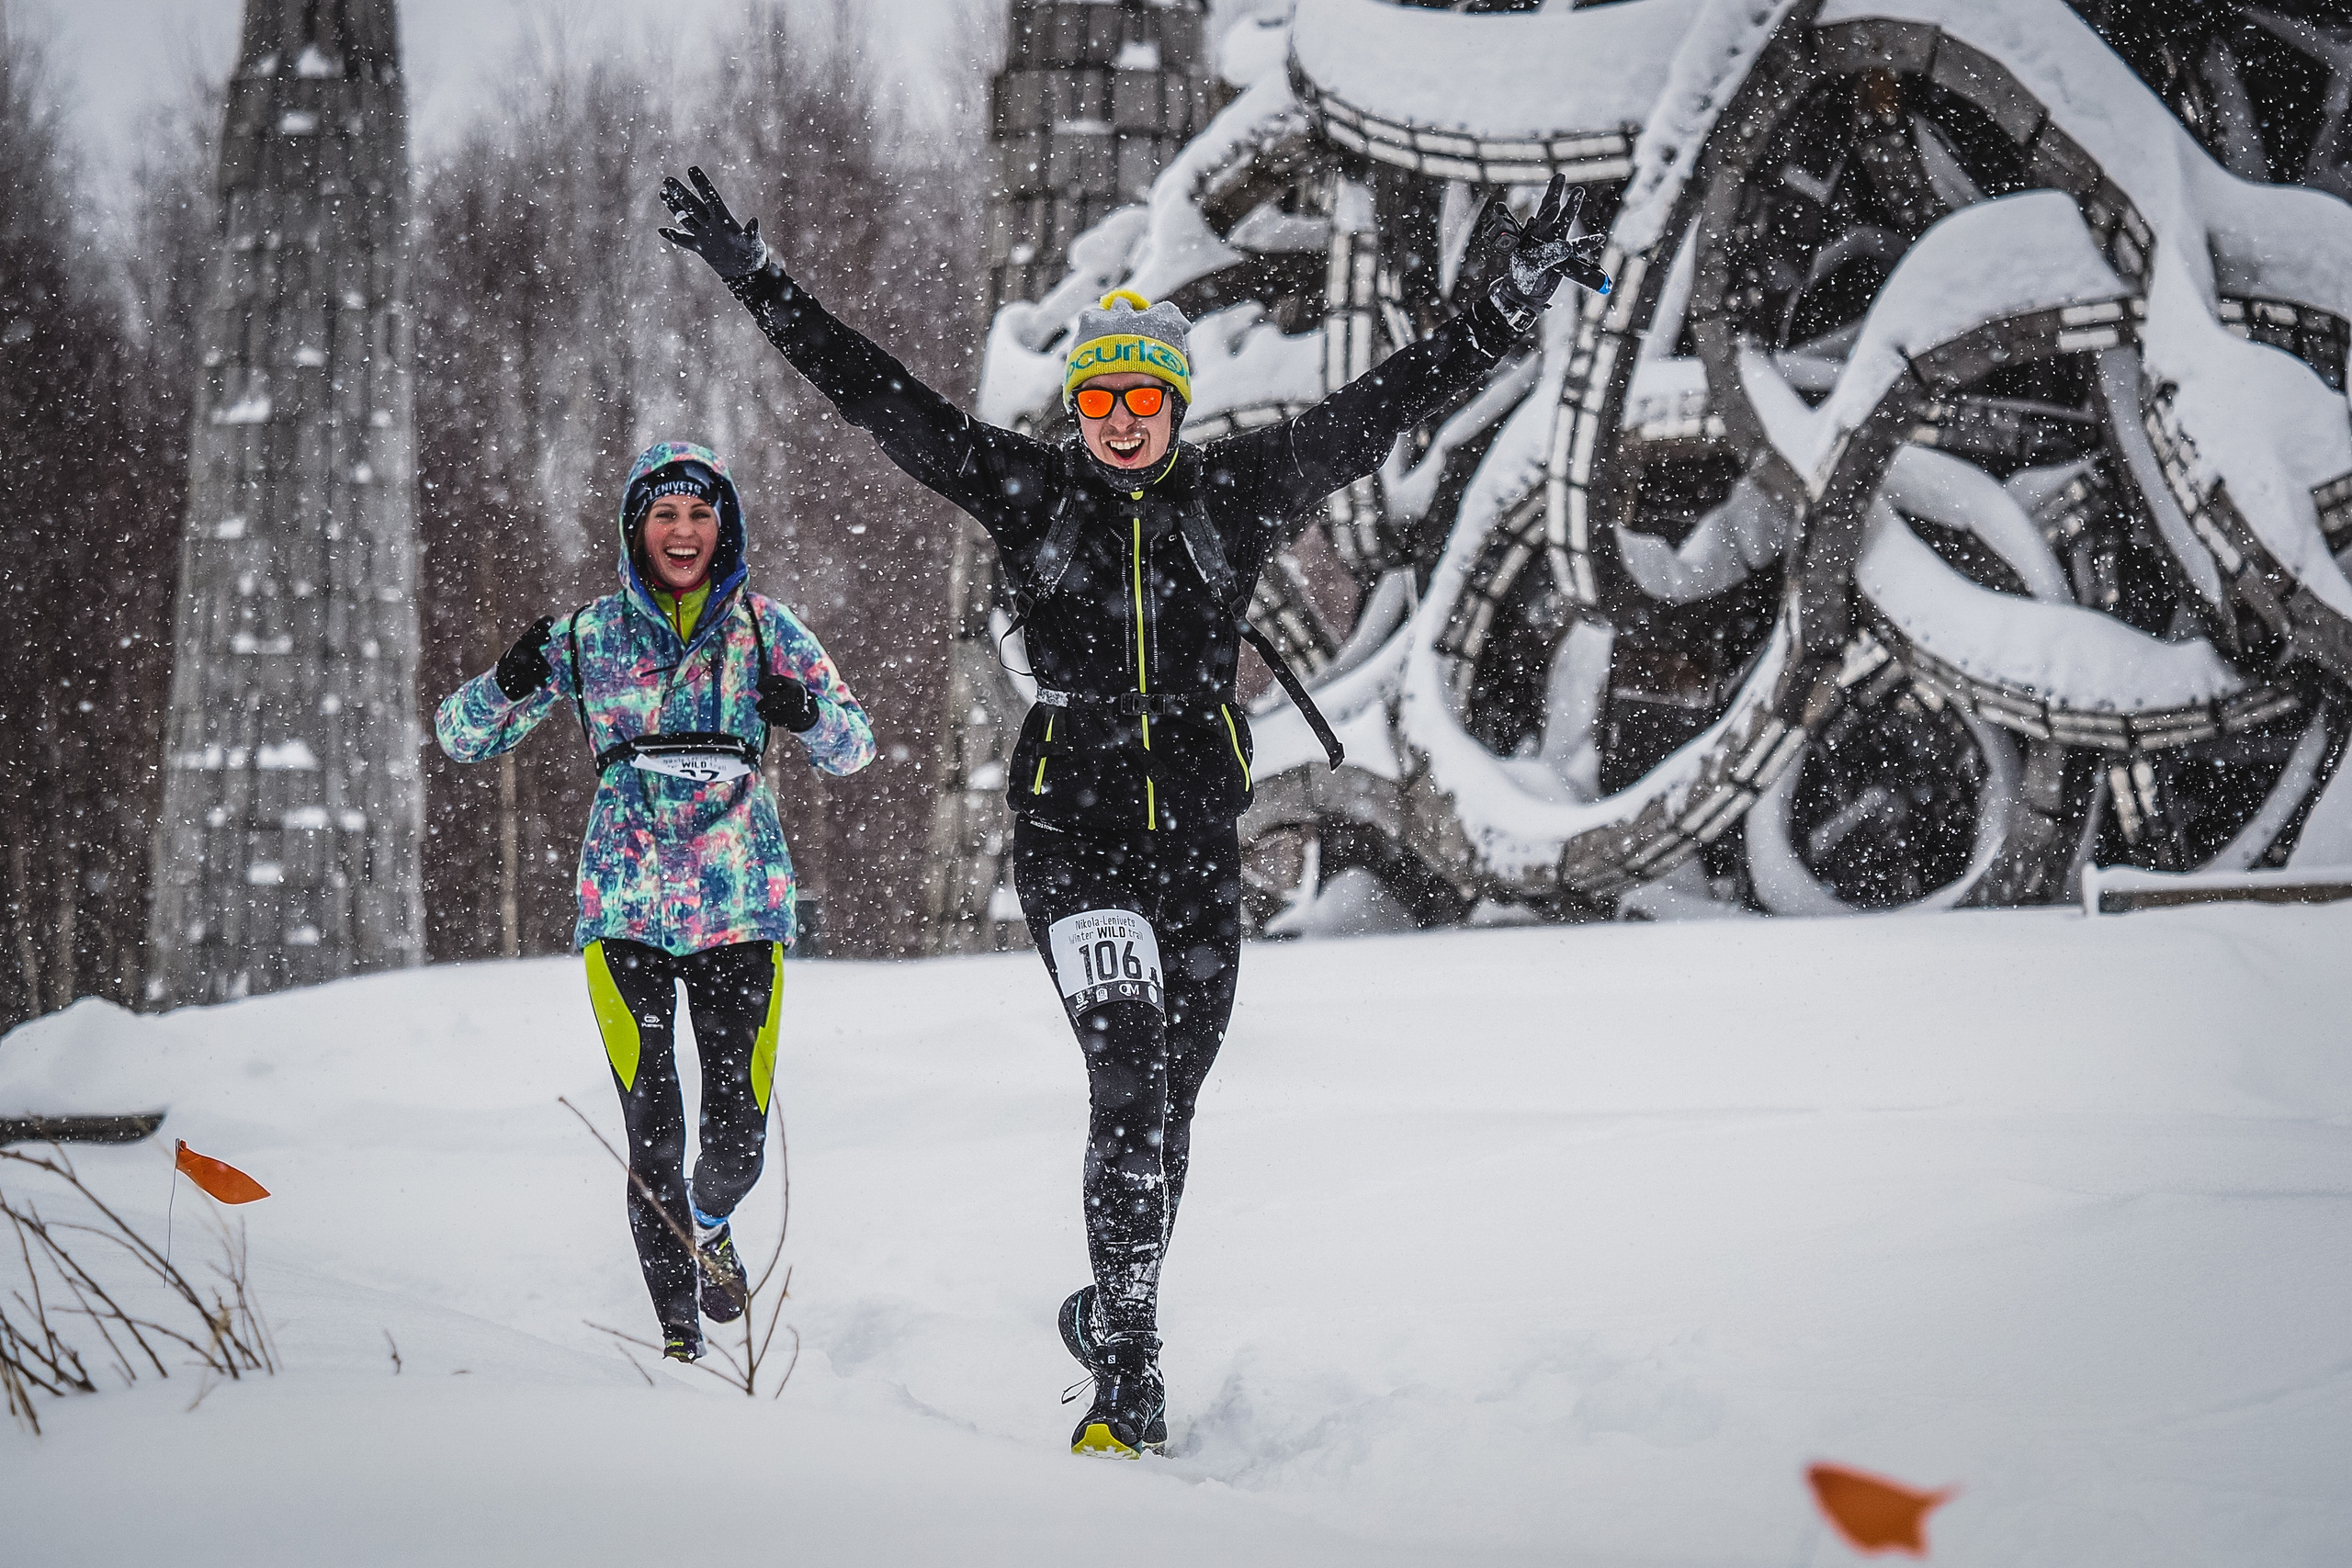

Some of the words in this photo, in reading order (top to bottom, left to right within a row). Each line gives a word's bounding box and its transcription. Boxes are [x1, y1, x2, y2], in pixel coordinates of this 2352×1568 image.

[648, 480, 703, 500] LENIVETS
[1075, 916, 1136, 931] Nikola-Lenivets
[1097, 926, 1125, 939] WILD
[1079, 940, 1143, 986] 106
